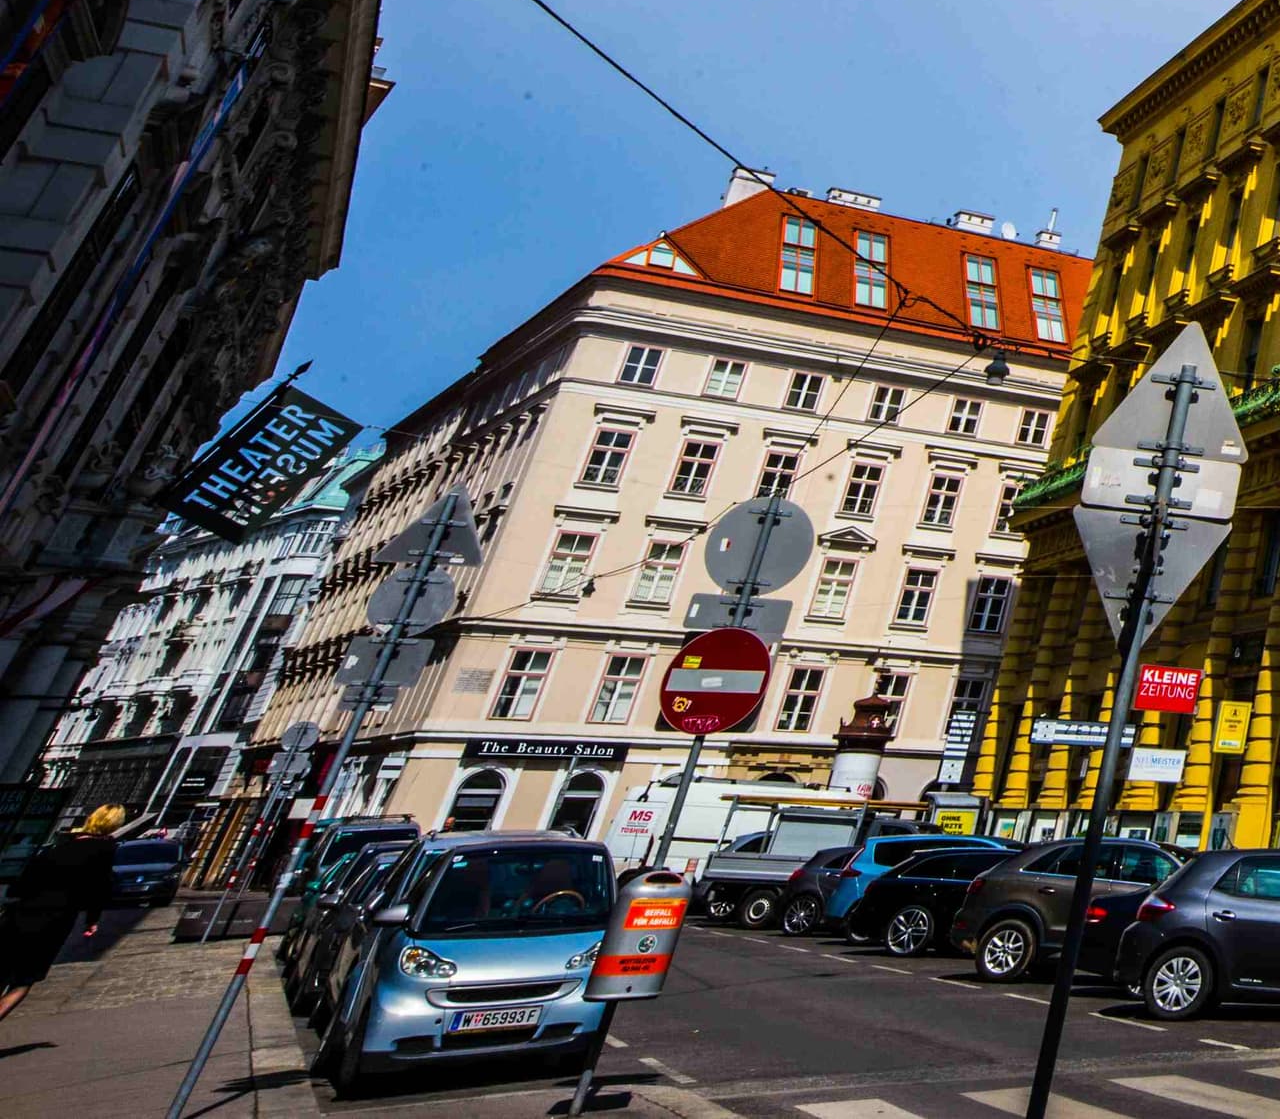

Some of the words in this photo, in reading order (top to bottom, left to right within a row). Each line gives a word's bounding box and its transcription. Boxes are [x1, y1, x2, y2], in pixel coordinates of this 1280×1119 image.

[183, 404, 316, 509] THEATER
[1142, 669, 1198, 685] KLEINE
[1140, 684, 1195, 699] ZEITUNG
[481, 741, 508, 753] The
[517, 742, 568, 756] Beauty
[574, 744, 615, 756] Salon
[629, 810, 653, 822] MS
[633, 917, 648, 926] FÜR
[461, 1013, 474, 1027] W
[482, 1010, 525, 1026] 65993
[526, 1009, 537, 1021] F
